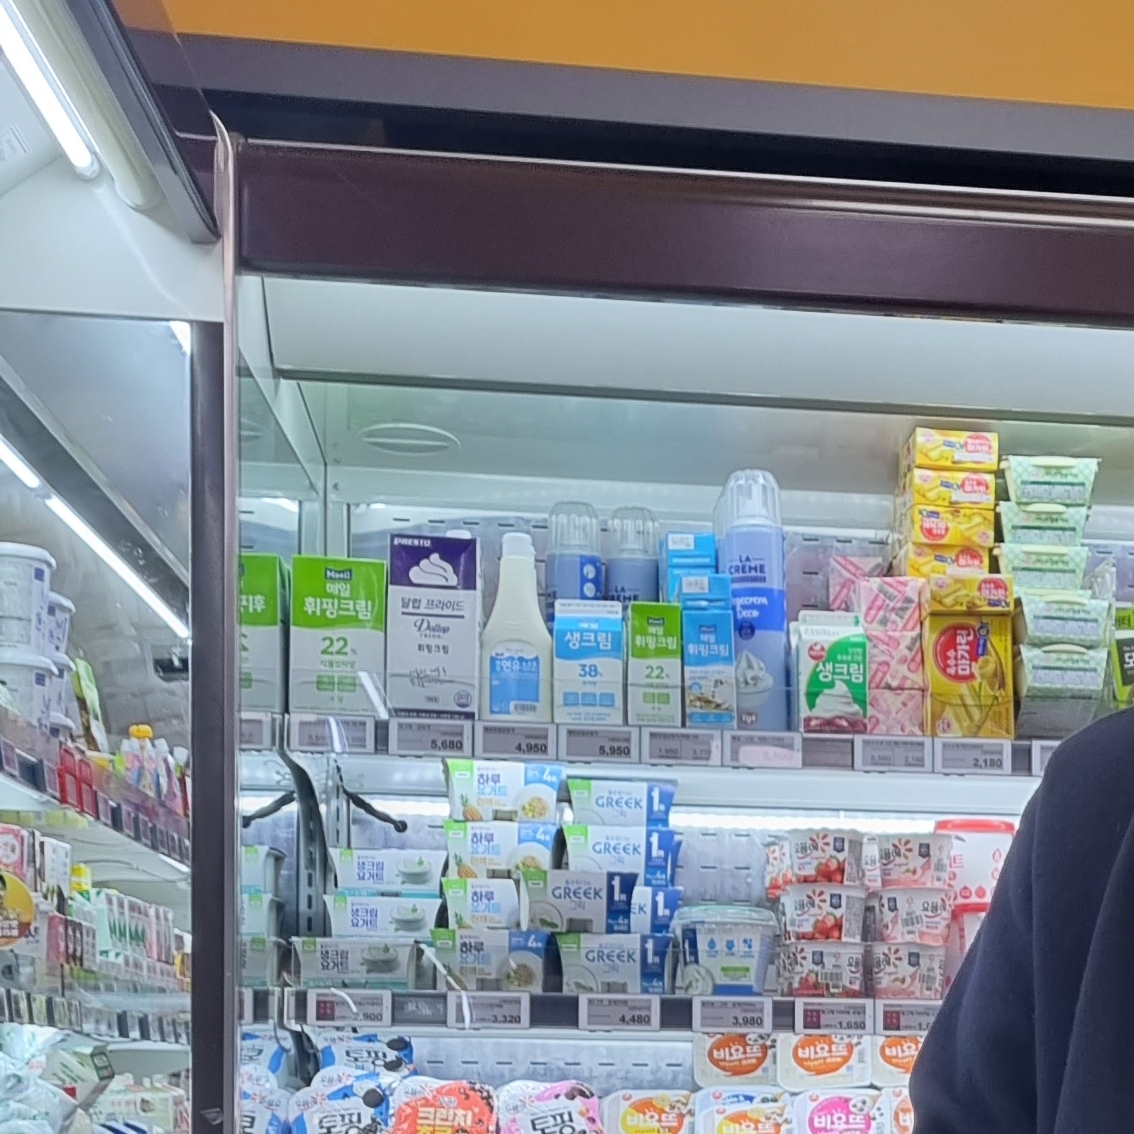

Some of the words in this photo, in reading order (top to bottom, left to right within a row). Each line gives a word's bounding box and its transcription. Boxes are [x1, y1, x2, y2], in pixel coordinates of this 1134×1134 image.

[326, 582, 351, 597] 매일
[304, 596, 372, 620] 휘핑크림
[424, 599, 465, 612] 프라이드
[565, 631, 612, 650] 생크림
[636, 636, 677, 649] 휘핑크림
[688, 644, 729, 656] 휘핑크림
[956, 629, 975, 675] 마가린
[816, 661, 864, 683] 생크림
[430, 739, 463, 750] 5,680
[515, 743, 548, 753] 4,950
[972, 758, 1002, 768] 2,180
[477, 774, 501, 785] 하루
[595, 796, 643, 810] GREEK
[471, 832, 495, 844] 하루
[592, 842, 641, 855] GREEK
[471, 891, 495, 902] 하루
[552, 886, 603, 900] GREEK
[460, 941, 484, 953] 하루
[585, 949, 637, 963] GREEK
[619, 1014, 651, 1024] 4,480
[732, 1016, 763, 1026] 3,980
[713, 1043, 763, 1060] 비요뜨
[798, 1043, 848, 1060] 비요뜨
[417, 1106, 473, 1127] 크런치
[627, 1110, 678, 1128] 비요뜨
[814, 1111, 866, 1130] 비요뜨
